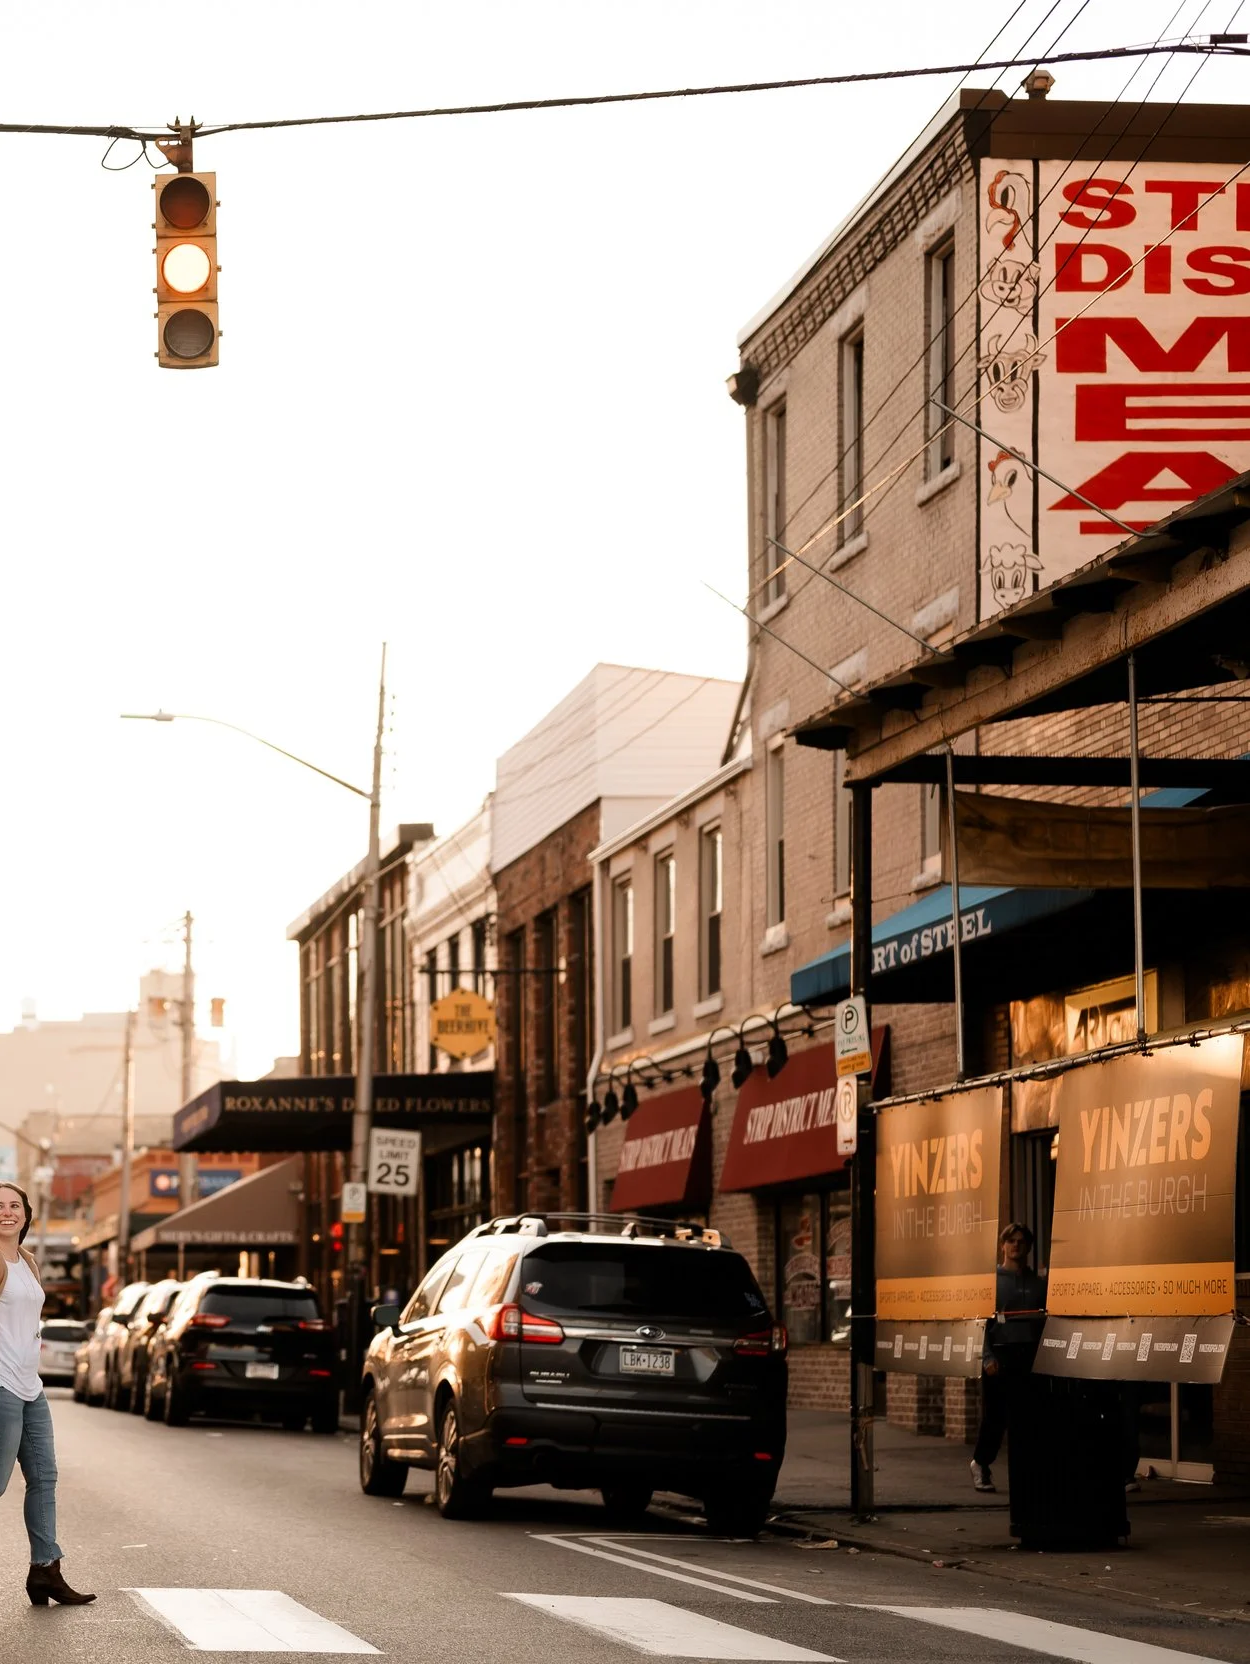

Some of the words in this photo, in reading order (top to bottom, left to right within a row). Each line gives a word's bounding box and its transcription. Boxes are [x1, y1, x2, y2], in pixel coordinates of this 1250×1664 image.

[1059, 178, 1250, 231] ST
[871, 941, 898, 974] RT
[900, 933, 918, 964] of
[920, 908, 991, 956] STEEL
[844, 1010, 854, 1029] P
[224, 1096, 335, 1112] ROXANNE'S
[405, 1098, 491, 1112] FLOWERS
[743, 1103, 774, 1145] STRIP
[769, 1092, 819, 1139] DISTRICT
[376, 1136, 417, 1149] SPEED
[1080, 1088, 1213, 1174] YINZERS
[376, 1162, 410, 1187] 25
[379, 1149, 409, 1161] LIMIT
[890, 1128, 983, 1199] YINZERS
[1078, 1185, 1097, 1222] IN
[1099, 1180, 1134, 1220] THE
[1136, 1173, 1207, 1218] BURGH
[893, 1208, 905, 1241] IN
[906, 1206, 935, 1239] THE
[938, 1200, 982, 1237] BURGH
[1052, 1283, 1076, 1297] SPORTS
[1076, 1282, 1104, 1296] APPAREL
[1109, 1281, 1156, 1296] ACCESSORIES
[1163, 1280, 1174, 1294] SO
[1176, 1279, 1201, 1294] MUCH
[1203, 1279, 1228, 1294] MORE
